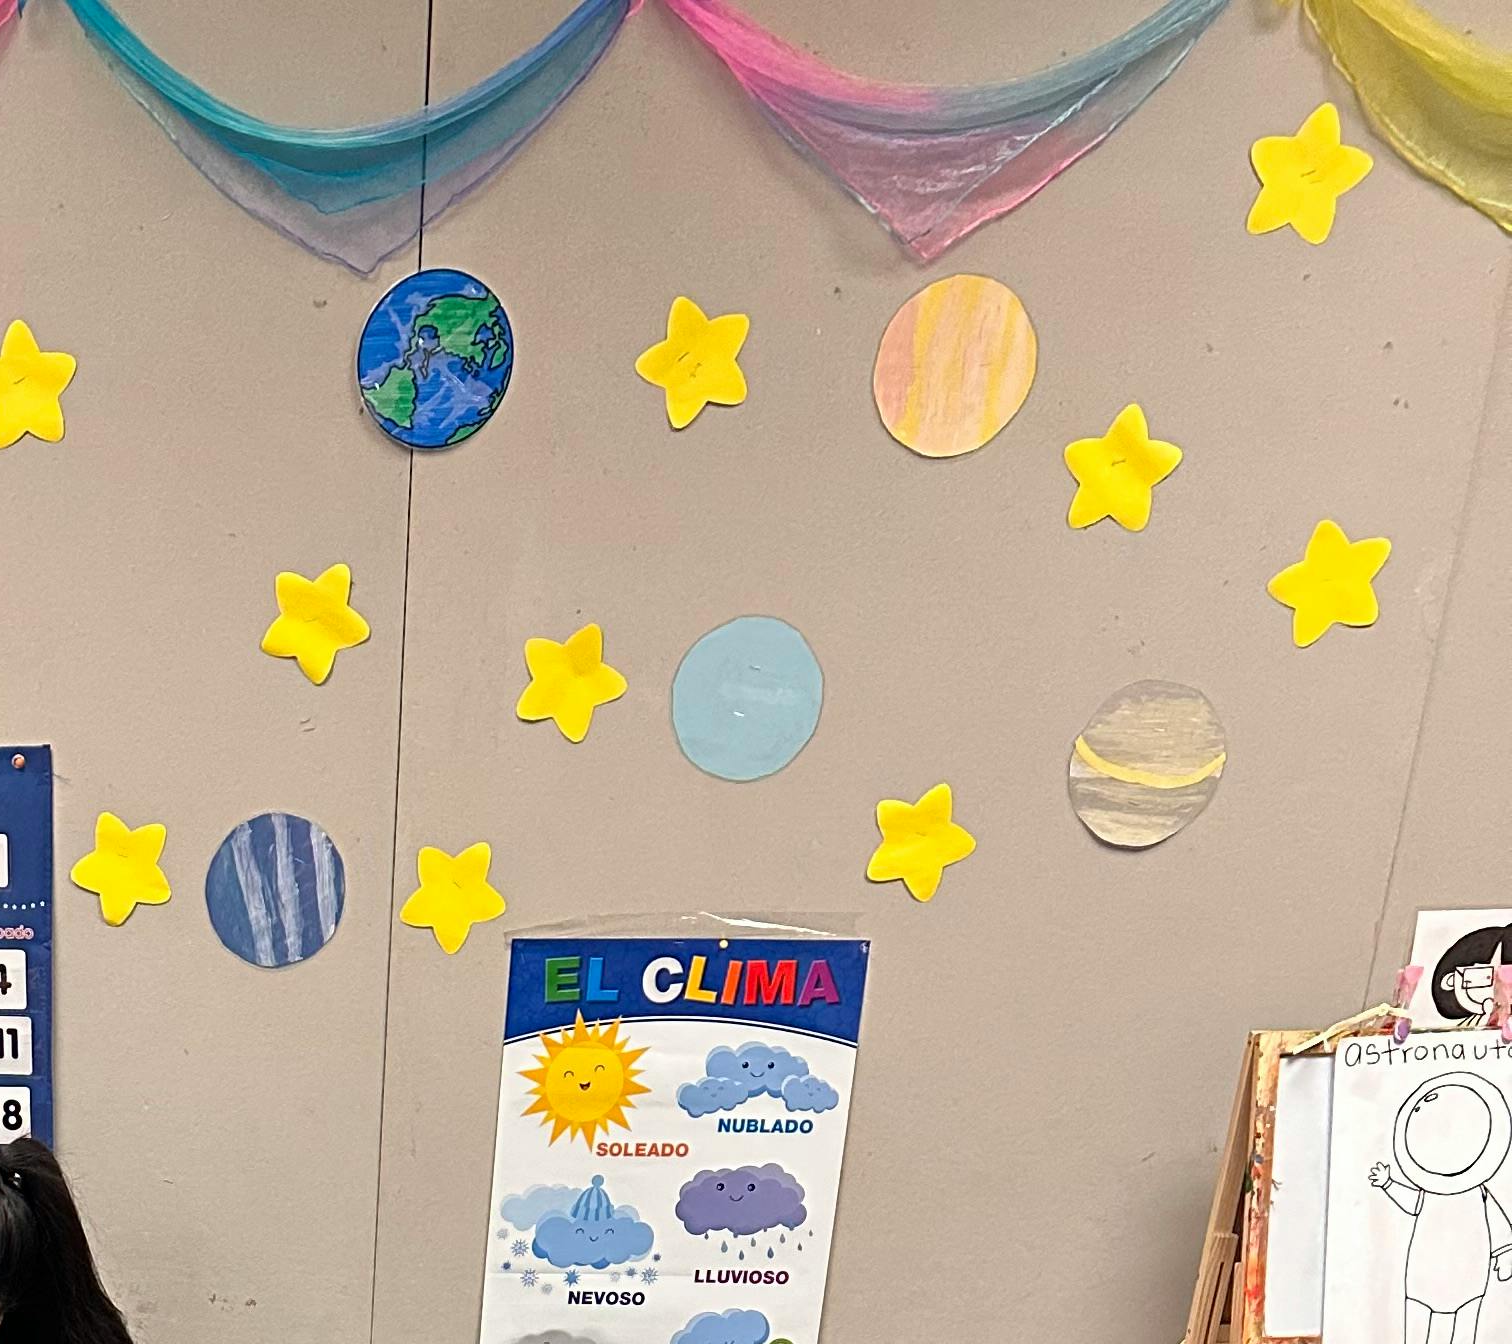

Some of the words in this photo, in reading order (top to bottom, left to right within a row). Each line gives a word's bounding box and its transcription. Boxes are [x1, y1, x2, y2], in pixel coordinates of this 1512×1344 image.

[544, 955, 620, 1006] EL
[641, 956, 841, 1006] CLIMA
[717, 1118, 814, 1134] NUBLADO
[595, 1142, 690, 1158] SOLEADO
[694, 1269, 790, 1285] LLUVIOSO
[567, 1290, 646, 1306] NEVOSO
